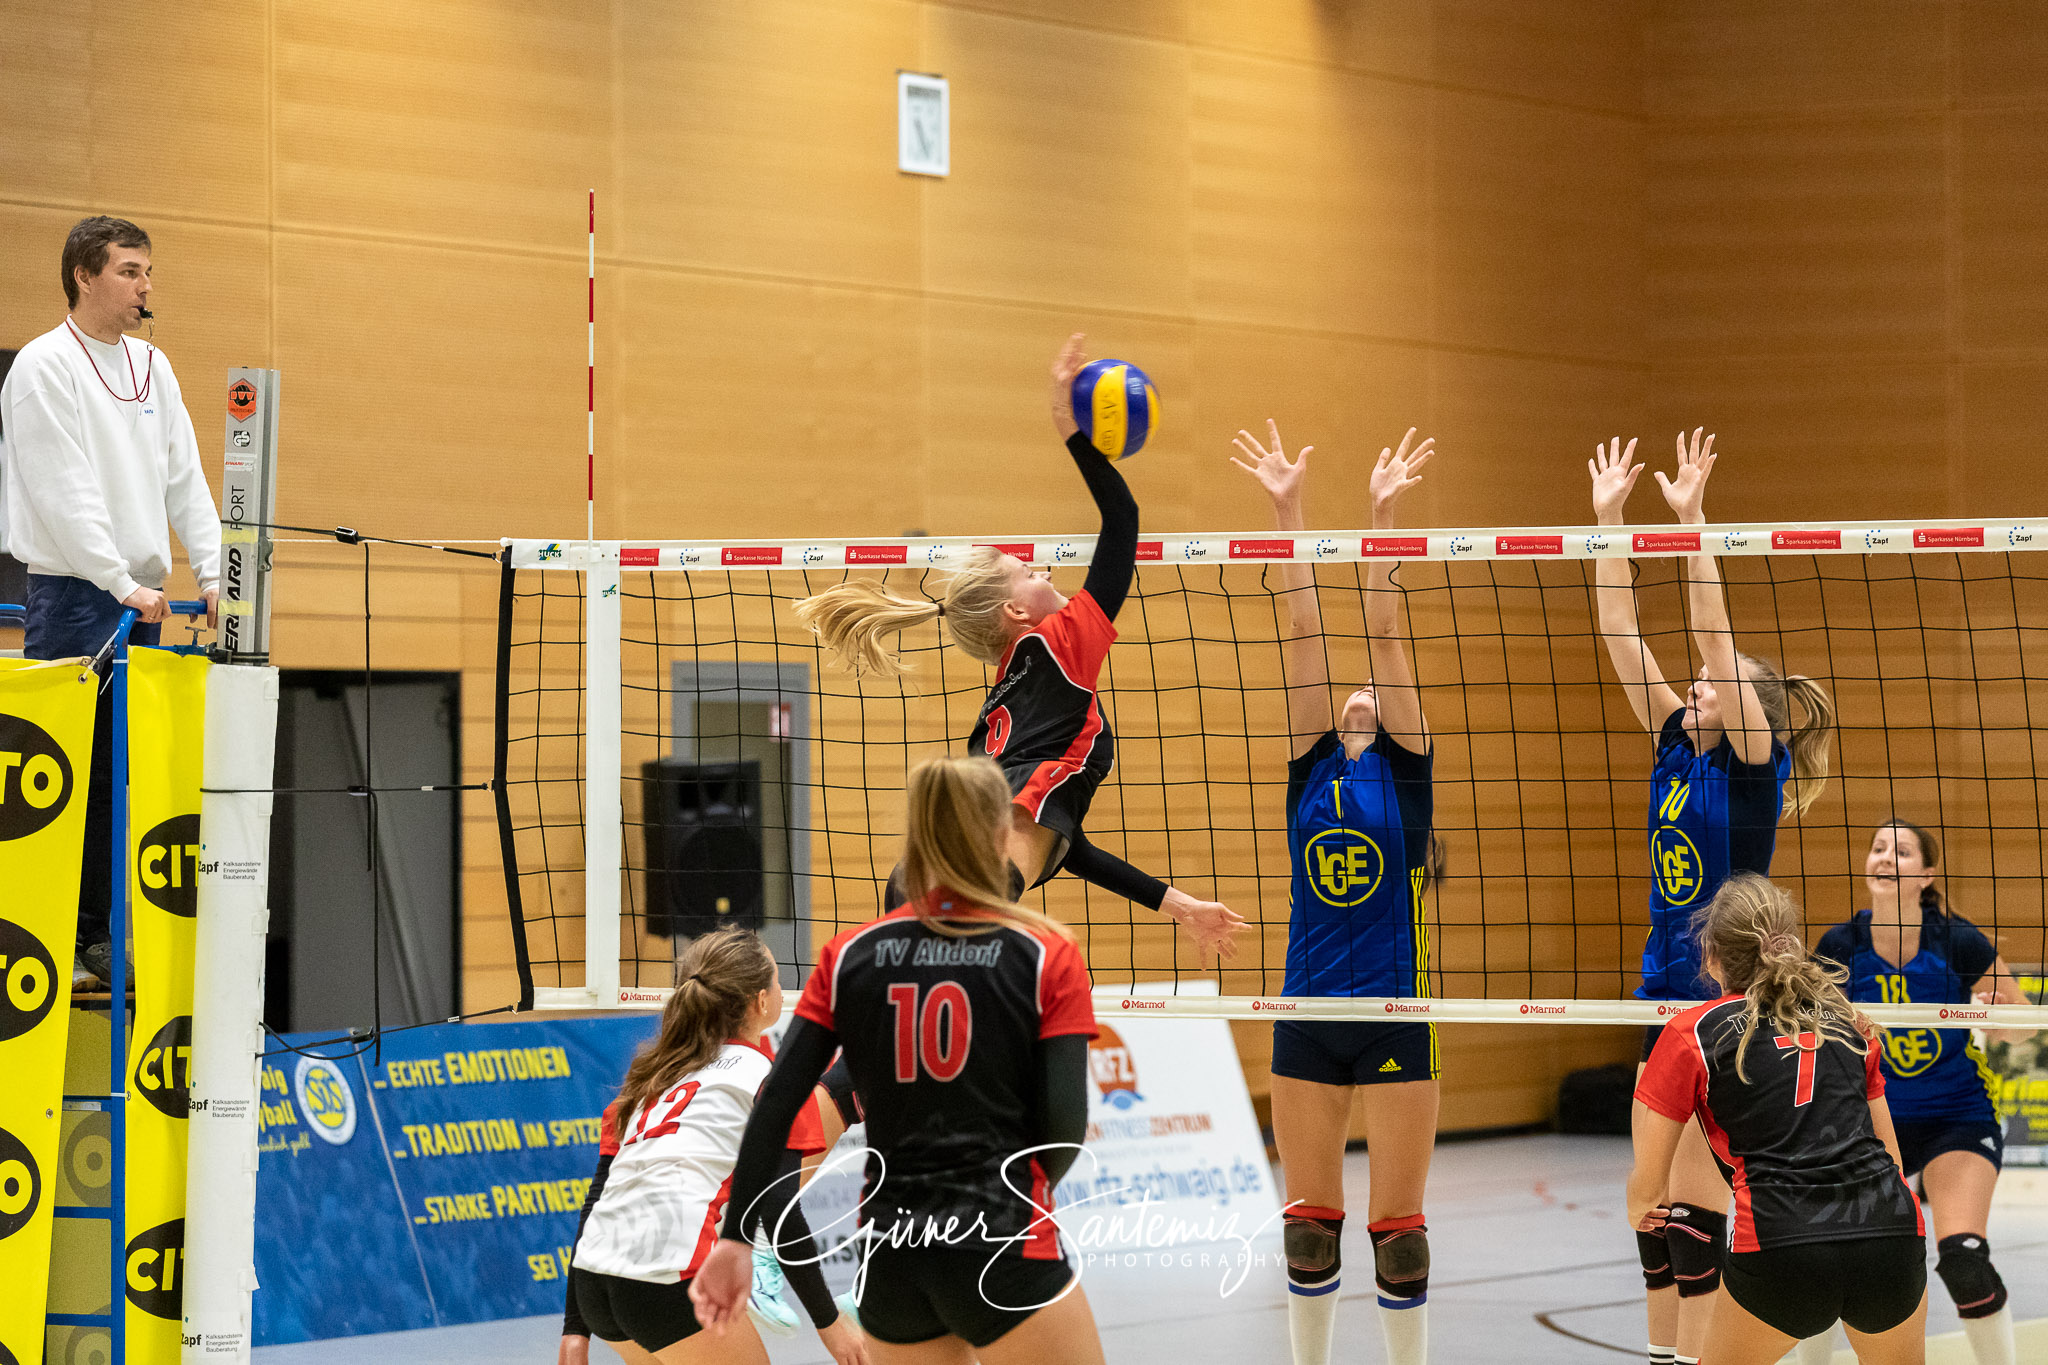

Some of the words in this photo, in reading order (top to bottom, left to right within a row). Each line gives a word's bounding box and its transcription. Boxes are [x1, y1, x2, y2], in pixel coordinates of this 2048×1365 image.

[538, 549, 562, 558] HUCK
[1872, 537, 1889, 545] Zapf
[225, 547, 242, 653] ERARD
[1659, 776, 1690, 822] 10
[875, 938, 911, 967] TV
[630, 992, 662, 1001] Marmot
[1131, 1000, 1166, 1008] Marmot
[1262, 1002, 1297, 1010] Marmot
[1395, 1003, 1430, 1012] Marmot
[1530, 1005, 1566, 1014] Marmot
[1949, 1010, 1988, 1018] Marmot
[888, 981, 972, 1083] 10
[444, 1046, 571, 1084] EMOTIONEN
[624, 1080, 701, 1146] 12
[522, 1122, 549, 1148] IM
[126, 1247, 184, 1292] CI
[528, 1253, 559, 1281] SEI
